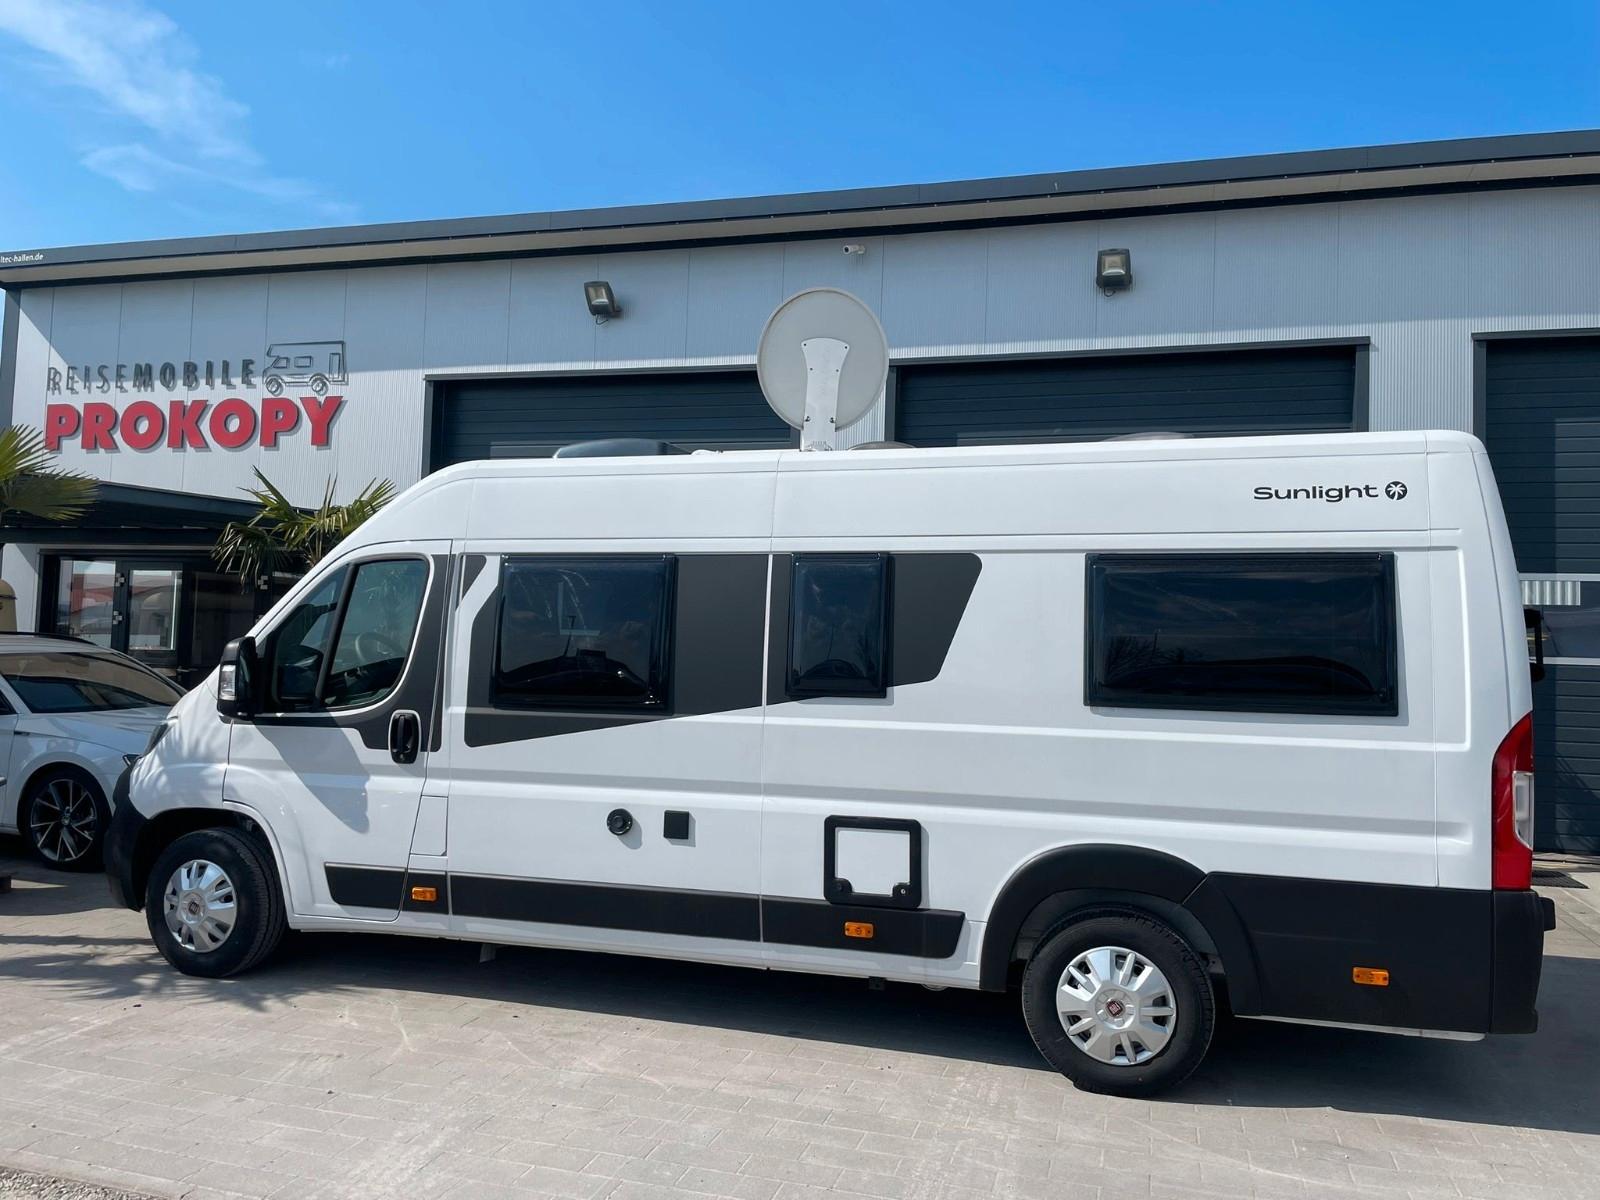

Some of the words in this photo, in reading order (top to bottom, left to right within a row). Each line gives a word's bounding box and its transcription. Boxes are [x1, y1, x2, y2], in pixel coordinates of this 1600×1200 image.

[47, 358, 257, 392] REISEMOBILE
[45, 395, 343, 451] PROKOPY
[1253, 484, 1379, 503] Sunlight
